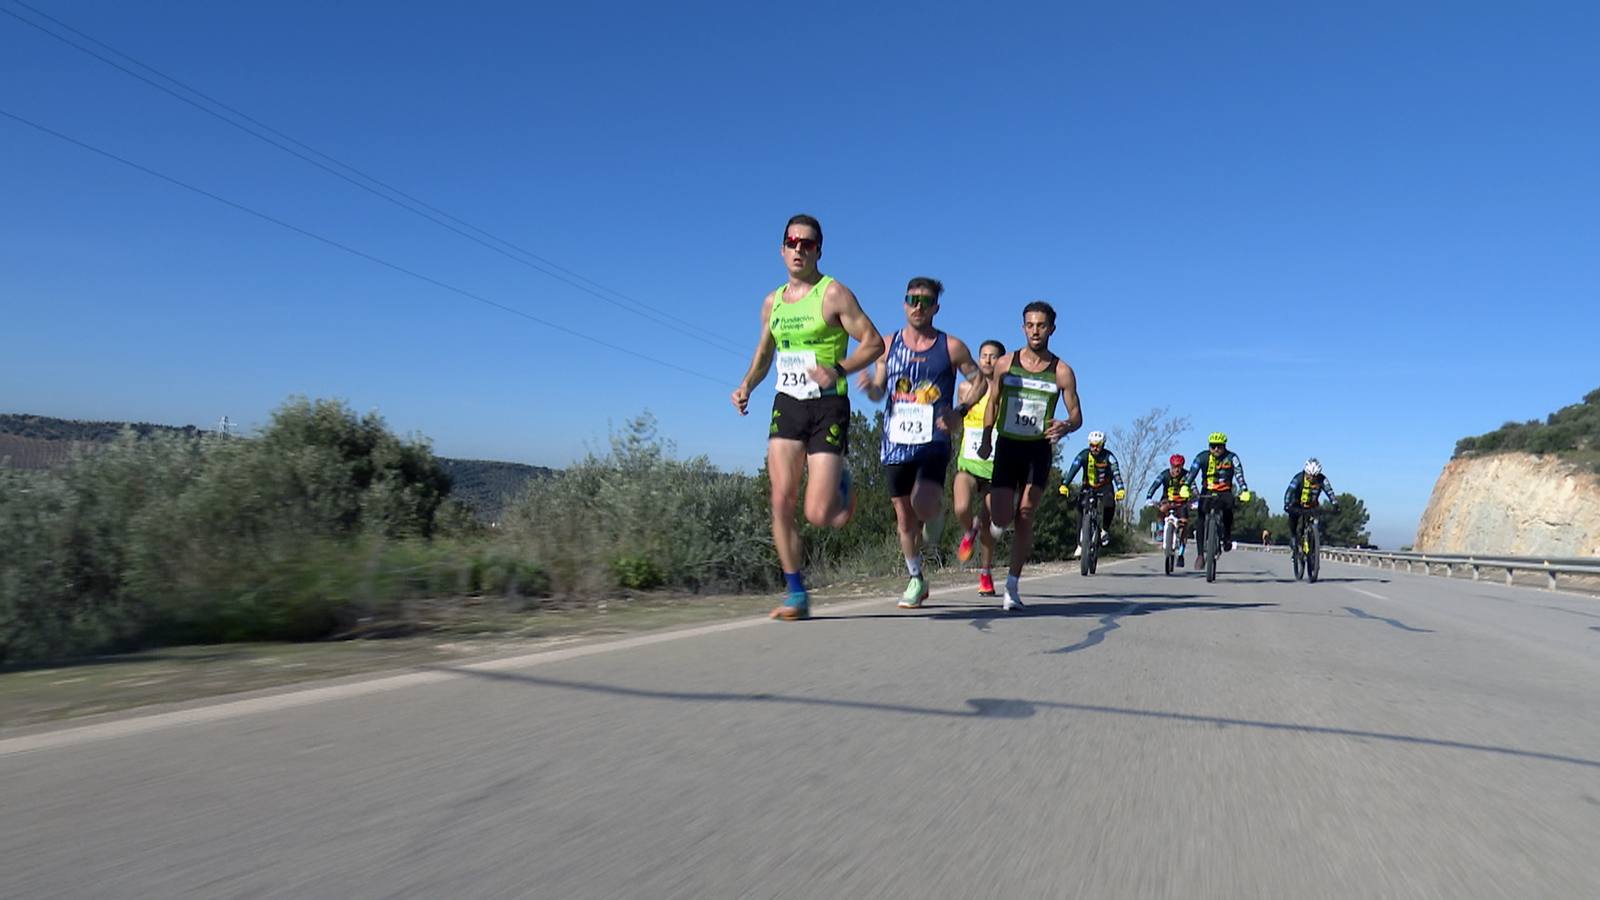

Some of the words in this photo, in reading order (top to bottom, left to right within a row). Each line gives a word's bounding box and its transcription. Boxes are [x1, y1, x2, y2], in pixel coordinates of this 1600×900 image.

[782, 372, 807, 386] 234
[1015, 414, 1037, 426] 190
[899, 421, 923, 433] 423
